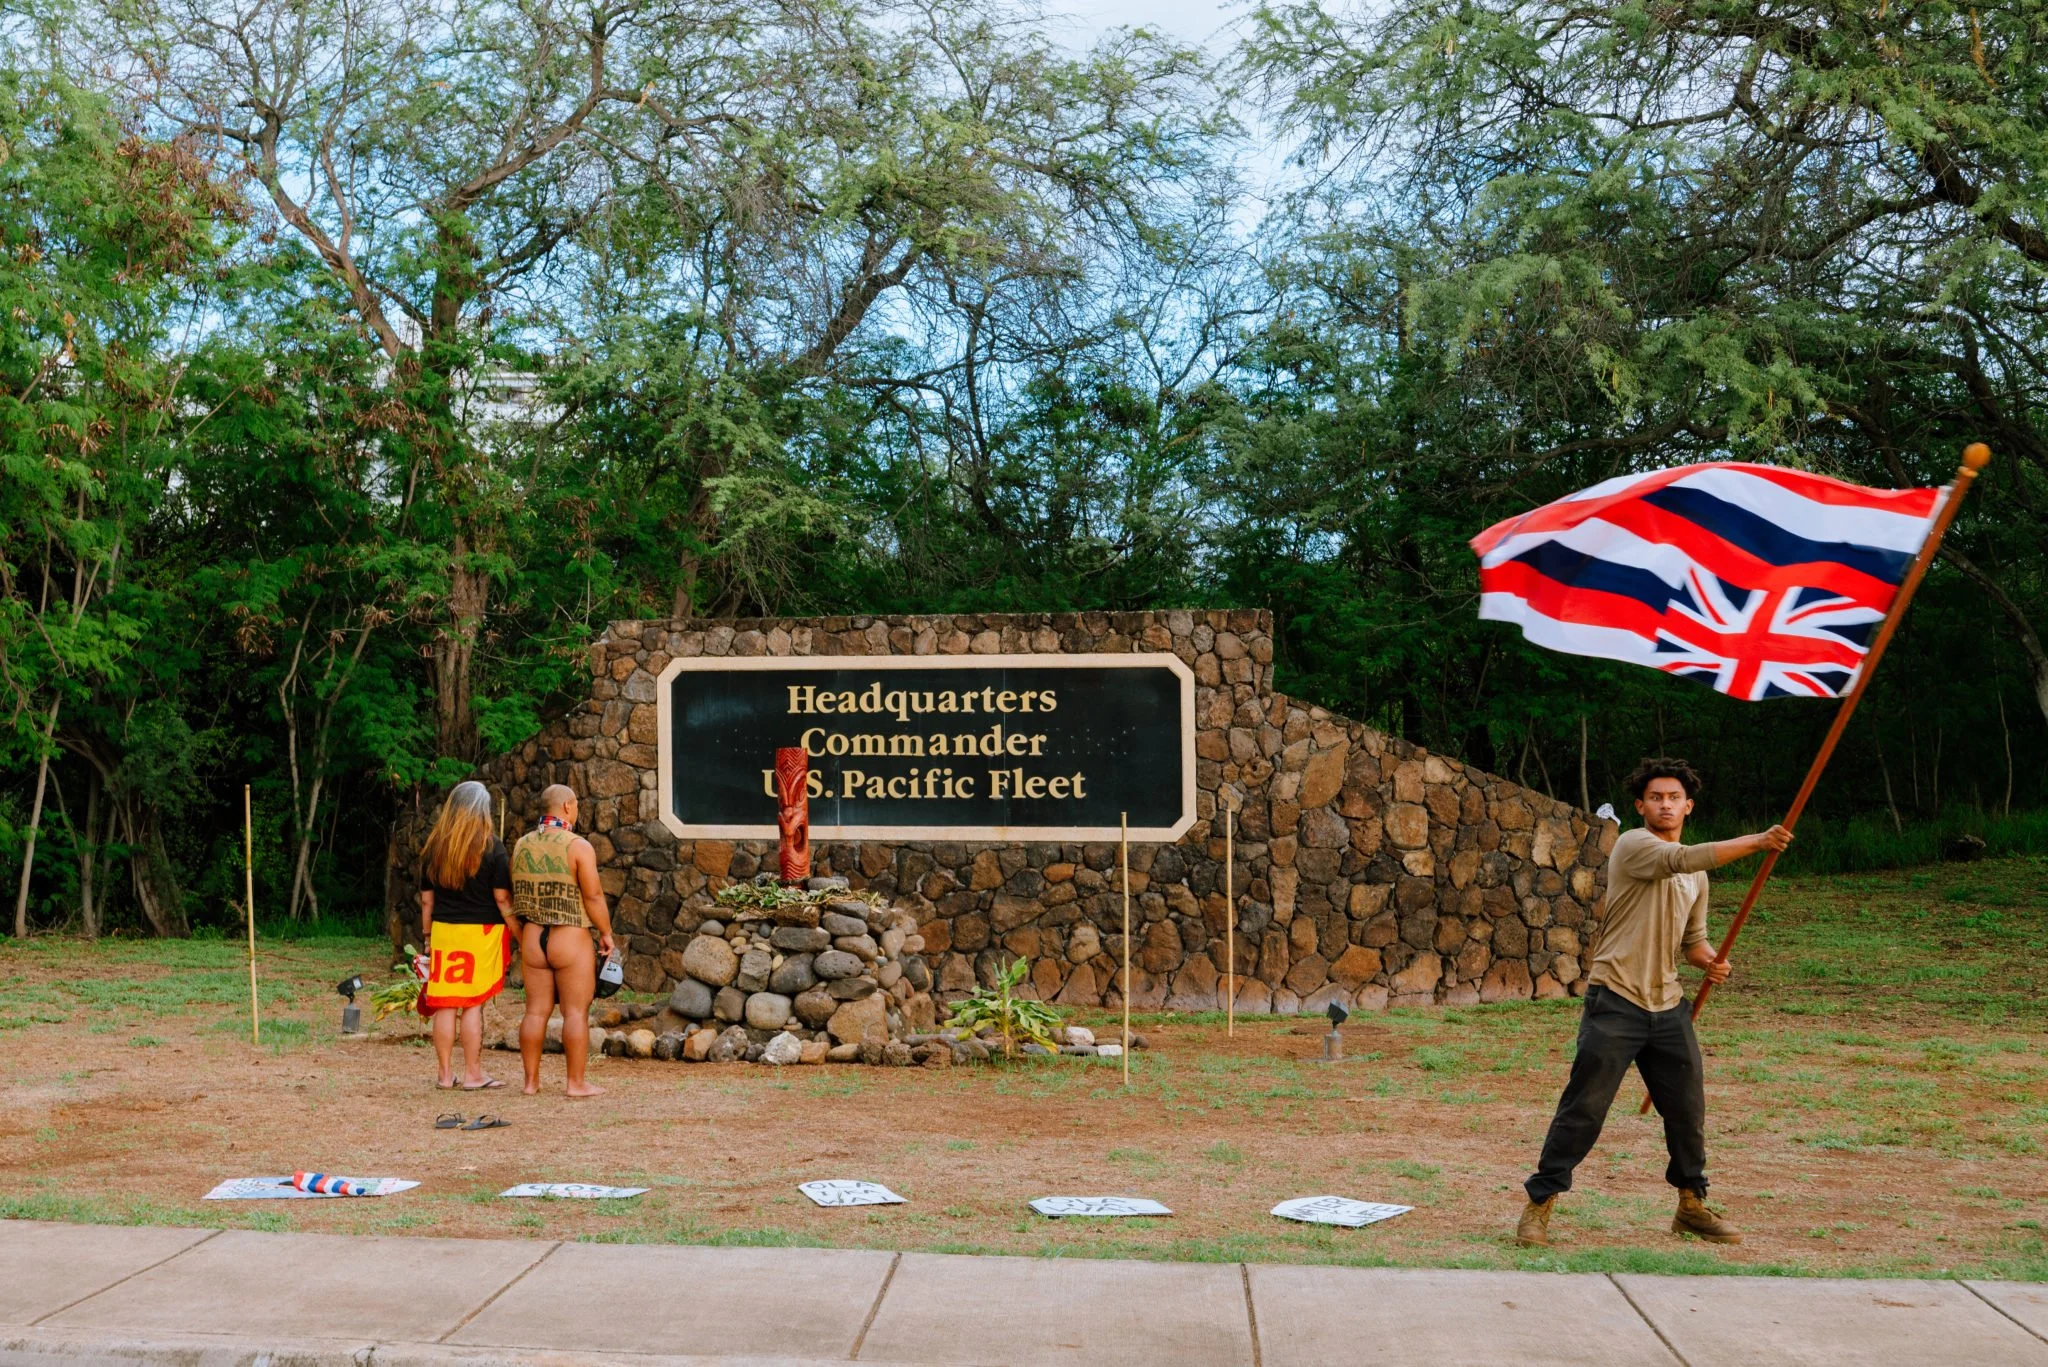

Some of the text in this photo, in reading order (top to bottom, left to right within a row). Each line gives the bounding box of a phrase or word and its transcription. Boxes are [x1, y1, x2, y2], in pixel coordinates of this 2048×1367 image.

[787, 682, 1057, 722] Headquarters
[801, 724, 1047, 757] Commander
[761, 767, 1087, 800] US. Pacific Fleet
[538, 881, 580, 900] COFFEE
